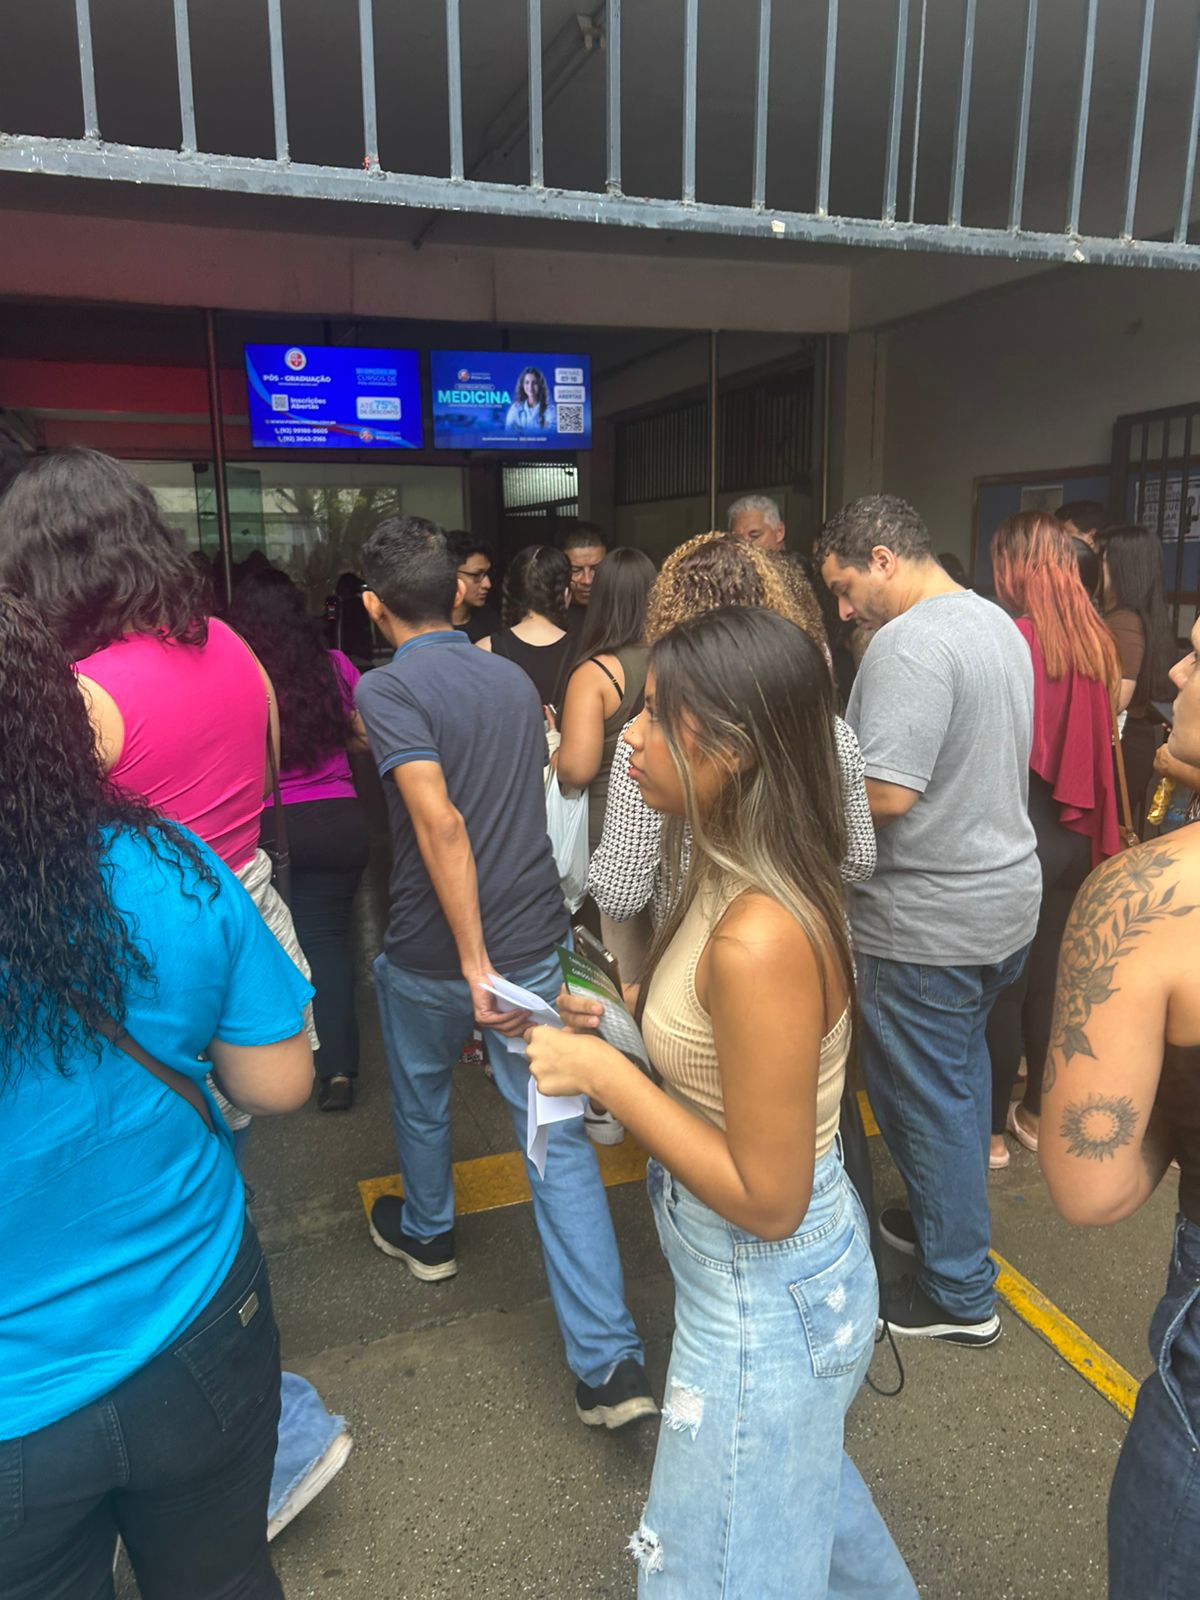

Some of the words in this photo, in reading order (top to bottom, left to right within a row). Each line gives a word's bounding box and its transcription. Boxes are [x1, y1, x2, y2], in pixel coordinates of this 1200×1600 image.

[285, 375, 331, 383] GRADUAÇÃO
[290, 397, 326, 405] Inscrições
[438, 390, 511, 404] MEDICINA
